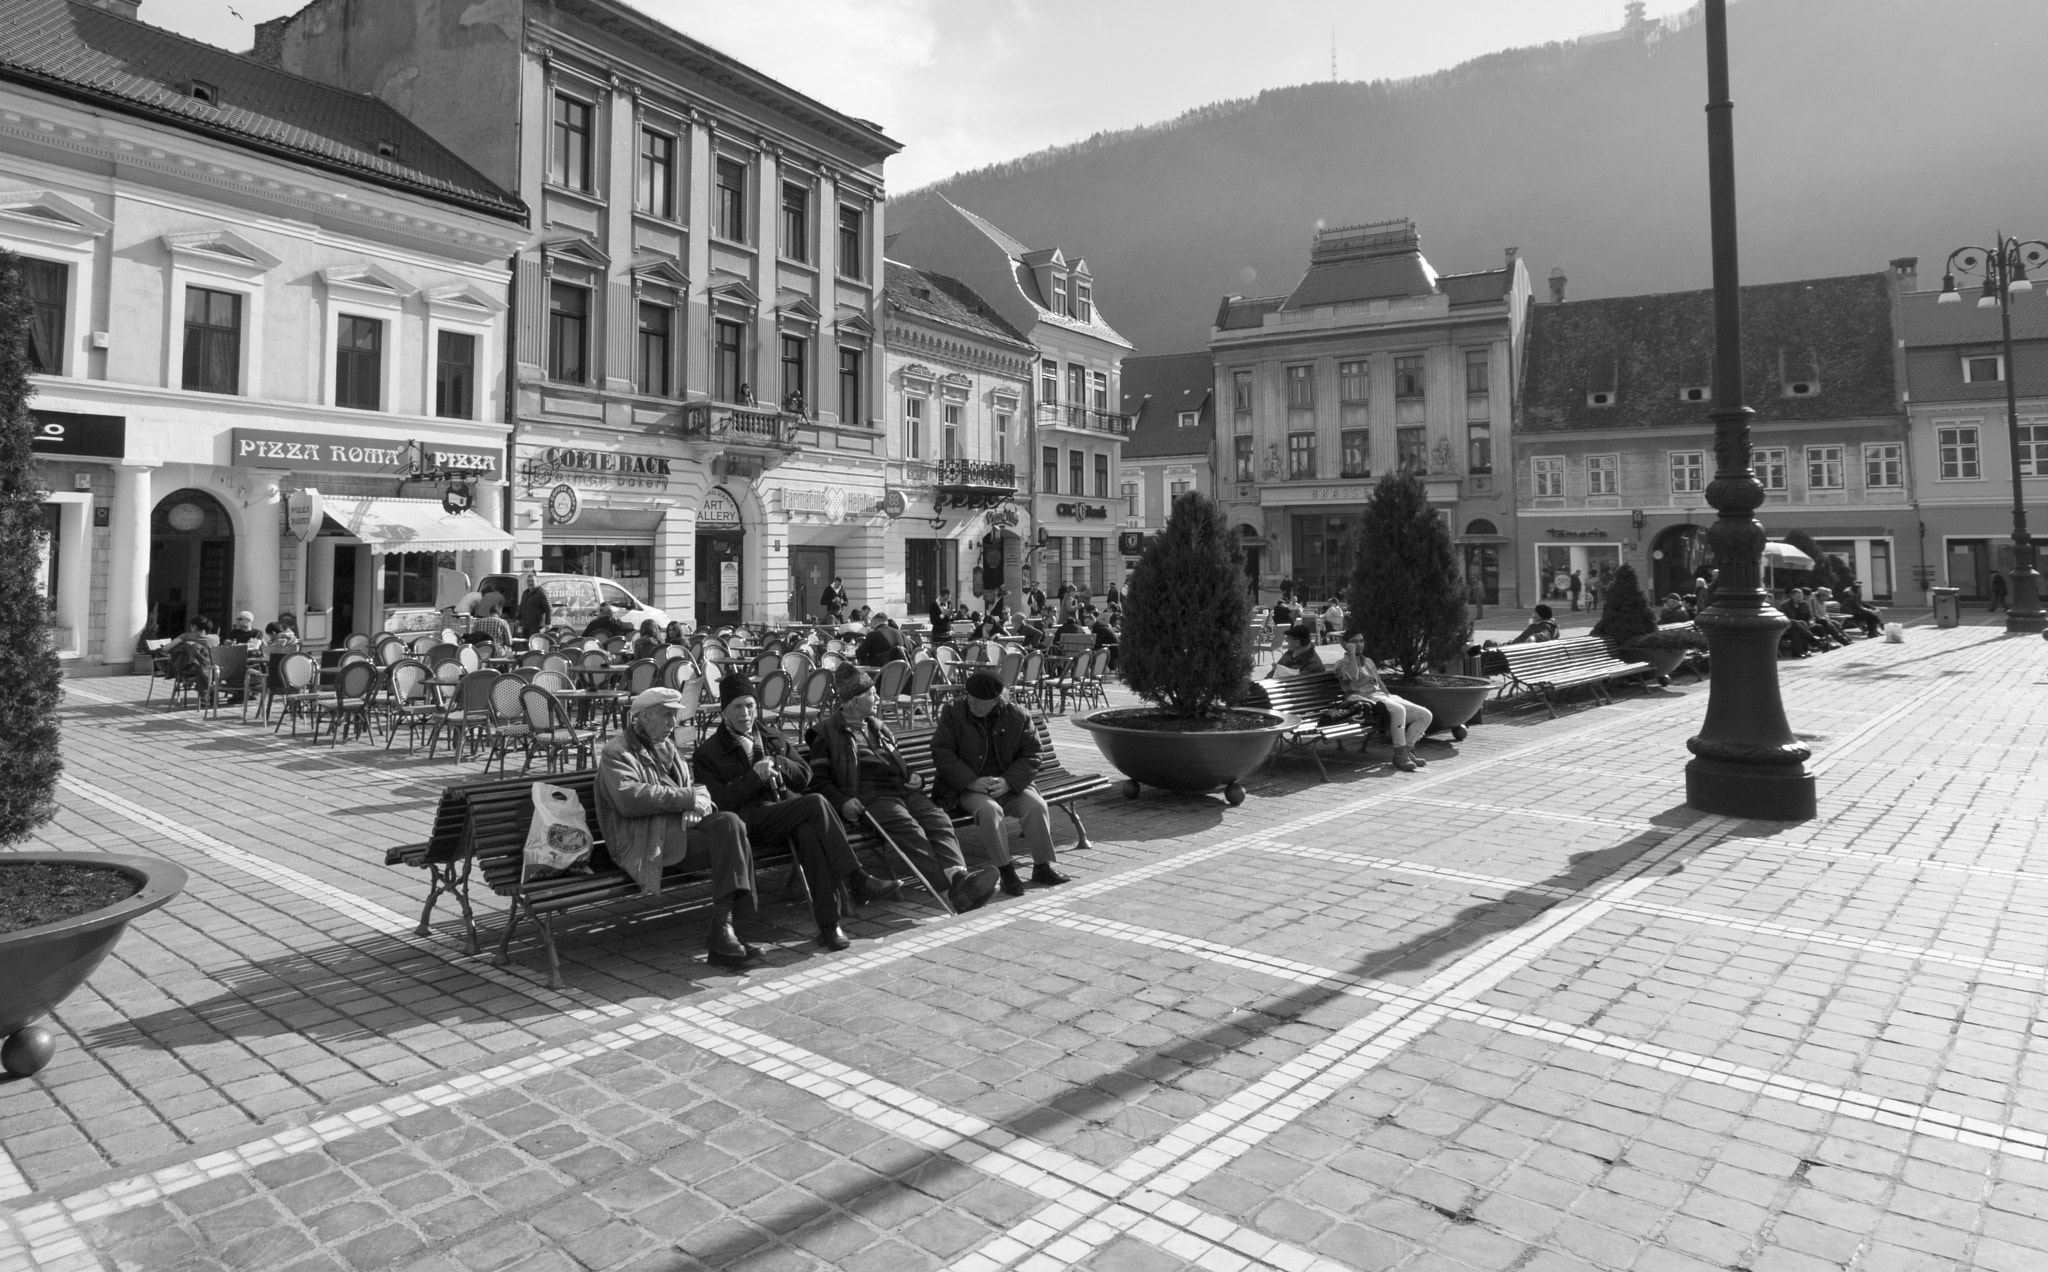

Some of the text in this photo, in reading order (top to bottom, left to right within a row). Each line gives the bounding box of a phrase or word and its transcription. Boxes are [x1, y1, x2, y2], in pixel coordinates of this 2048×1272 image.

[239, 439, 320, 461] PIZZA
[434, 451, 496, 470] PIZZA
[619, 455, 672, 476] BACK
[549, 473, 669, 492] erman bakery
[1311, 486, 1372, 499] BRASSE
[703, 500, 724, 510] ART
[697, 511, 736, 521] ALLERY
